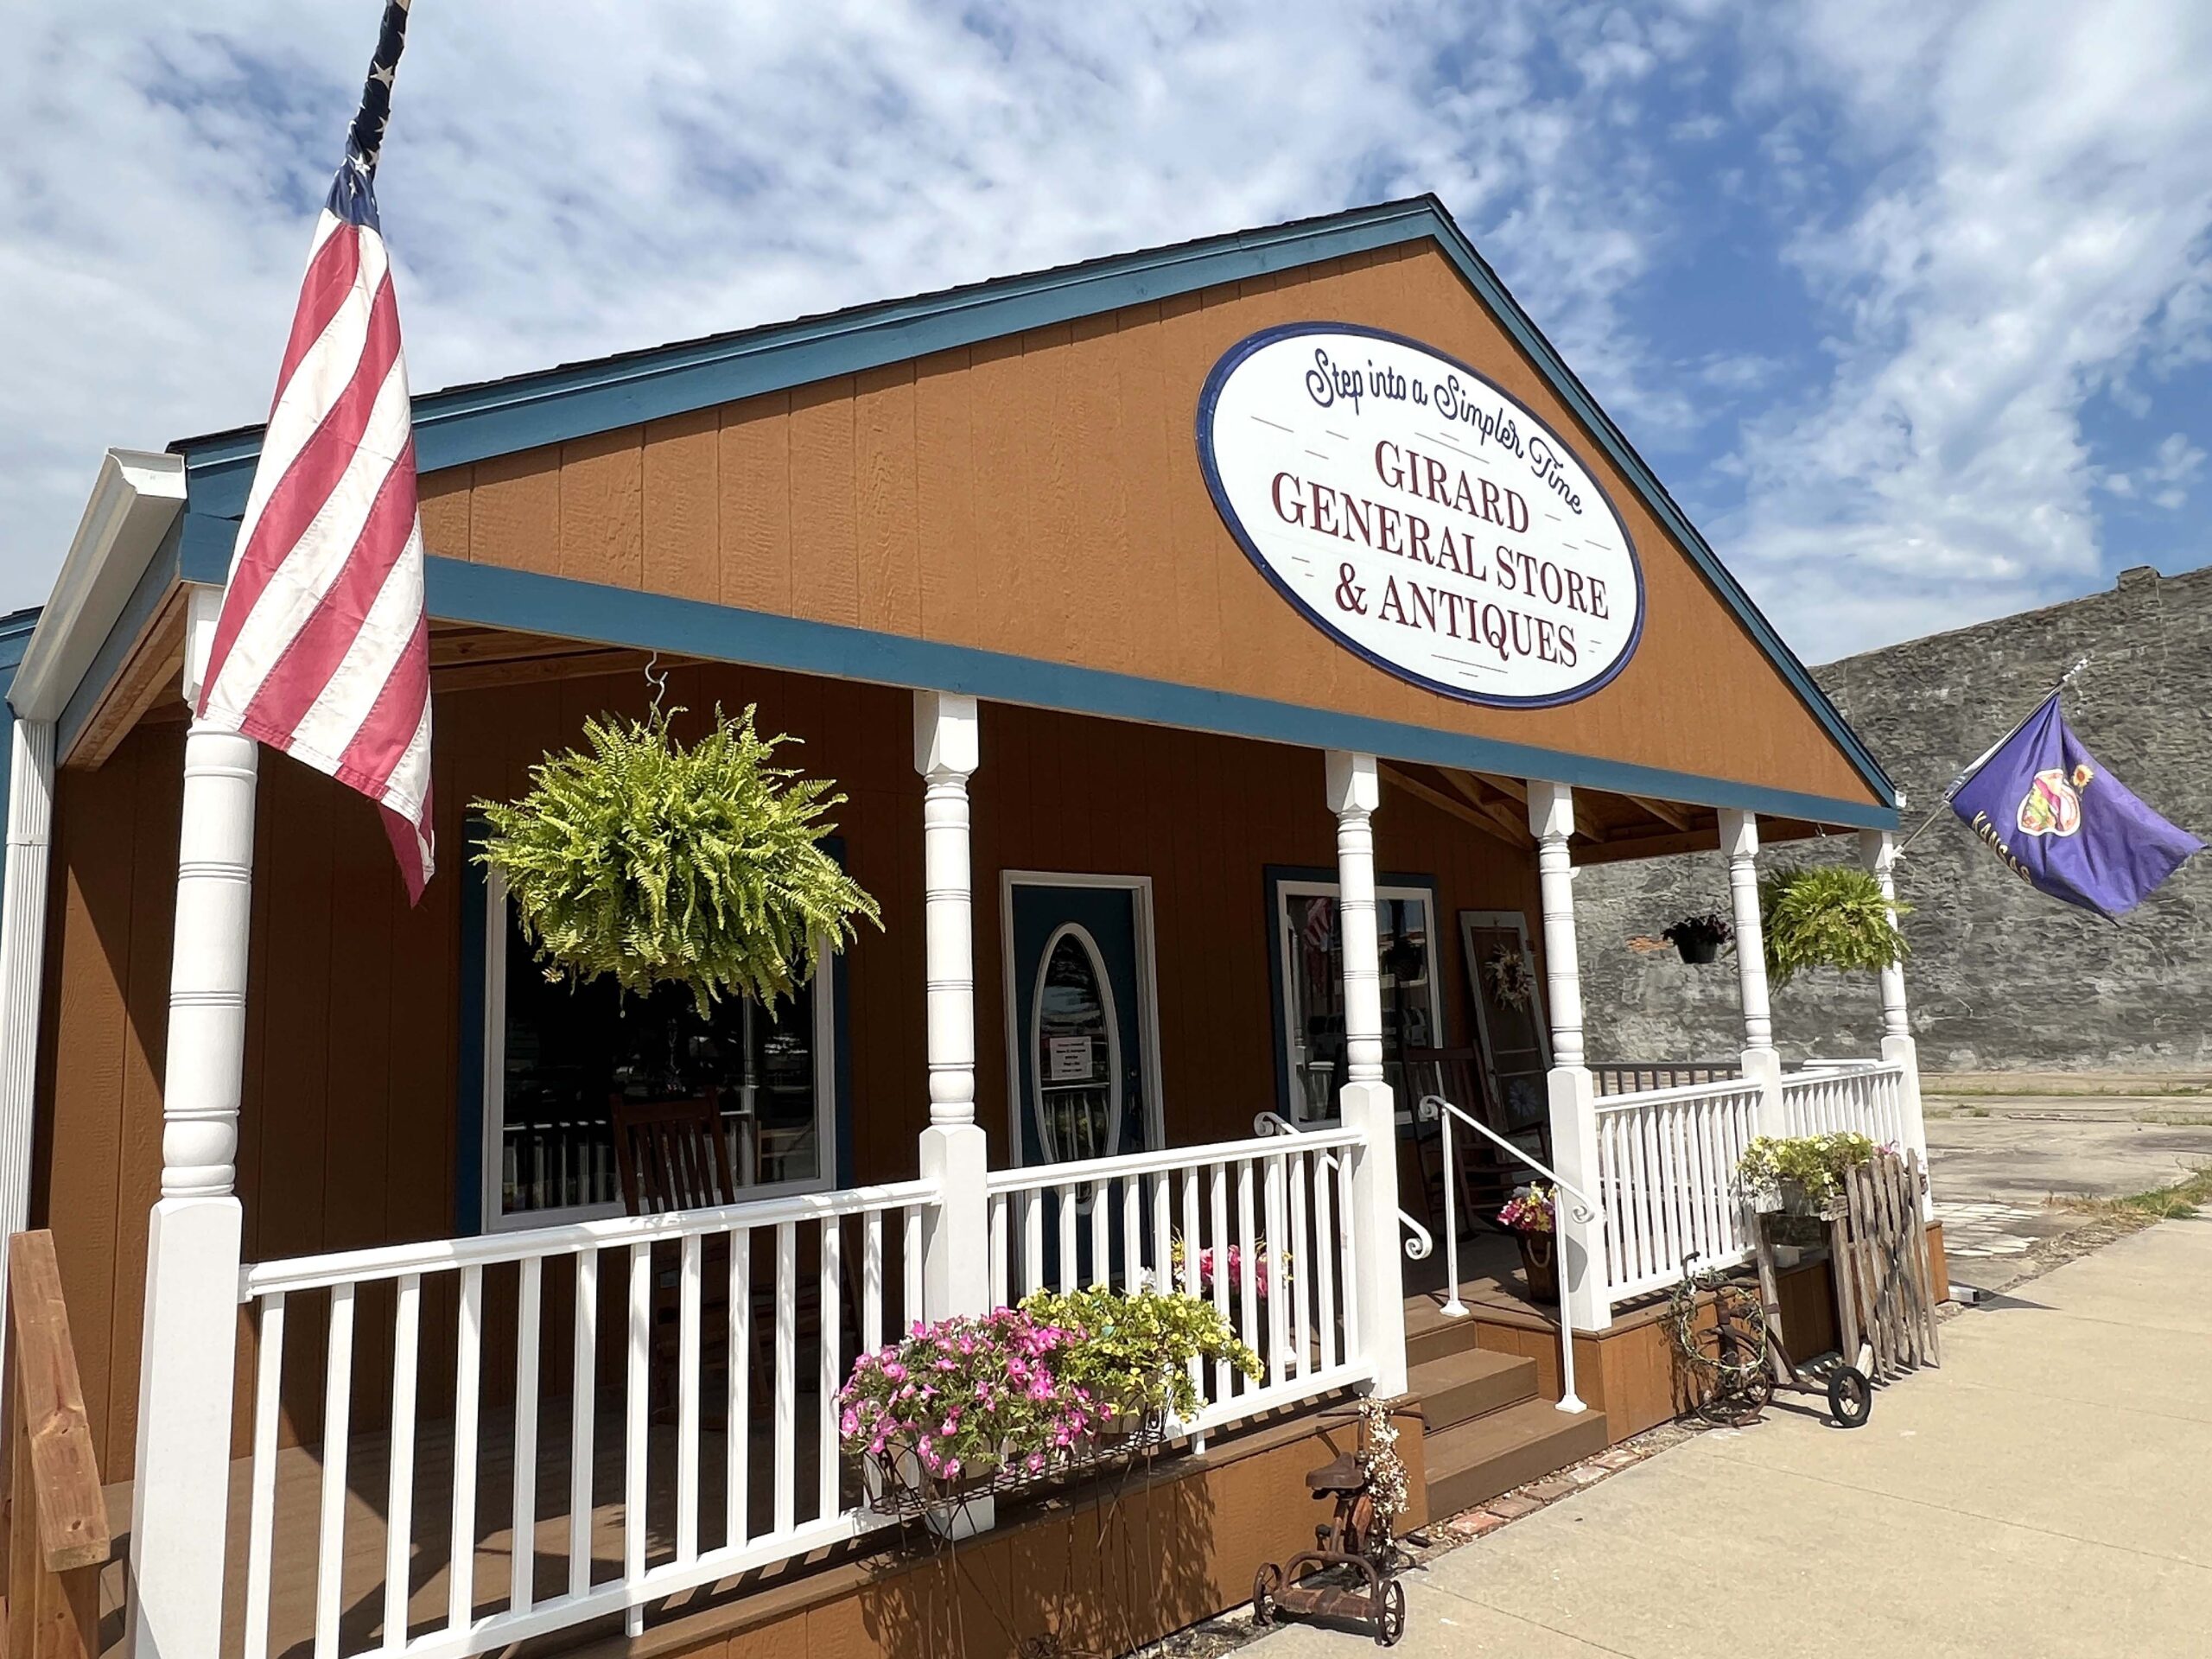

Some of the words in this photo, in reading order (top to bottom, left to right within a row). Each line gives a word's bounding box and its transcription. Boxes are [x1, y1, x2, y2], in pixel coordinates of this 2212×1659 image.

[1306, 347, 1363, 416] Step
[1367, 359, 1407, 402] into
[1412, 378, 1428, 406] a
[1433, 373, 1524, 460] Simpler
[1529, 435, 1583, 516] Time
[1375, 440, 1529, 534] GIRARD
[1270, 471, 1487, 582] GENERAL
[1496, 544, 1610, 620] STORE
[1334, 562, 1368, 616] &
[1377, 574, 1578, 668] ANTIQUES
[1972, 810, 2032, 886] KANSAS
